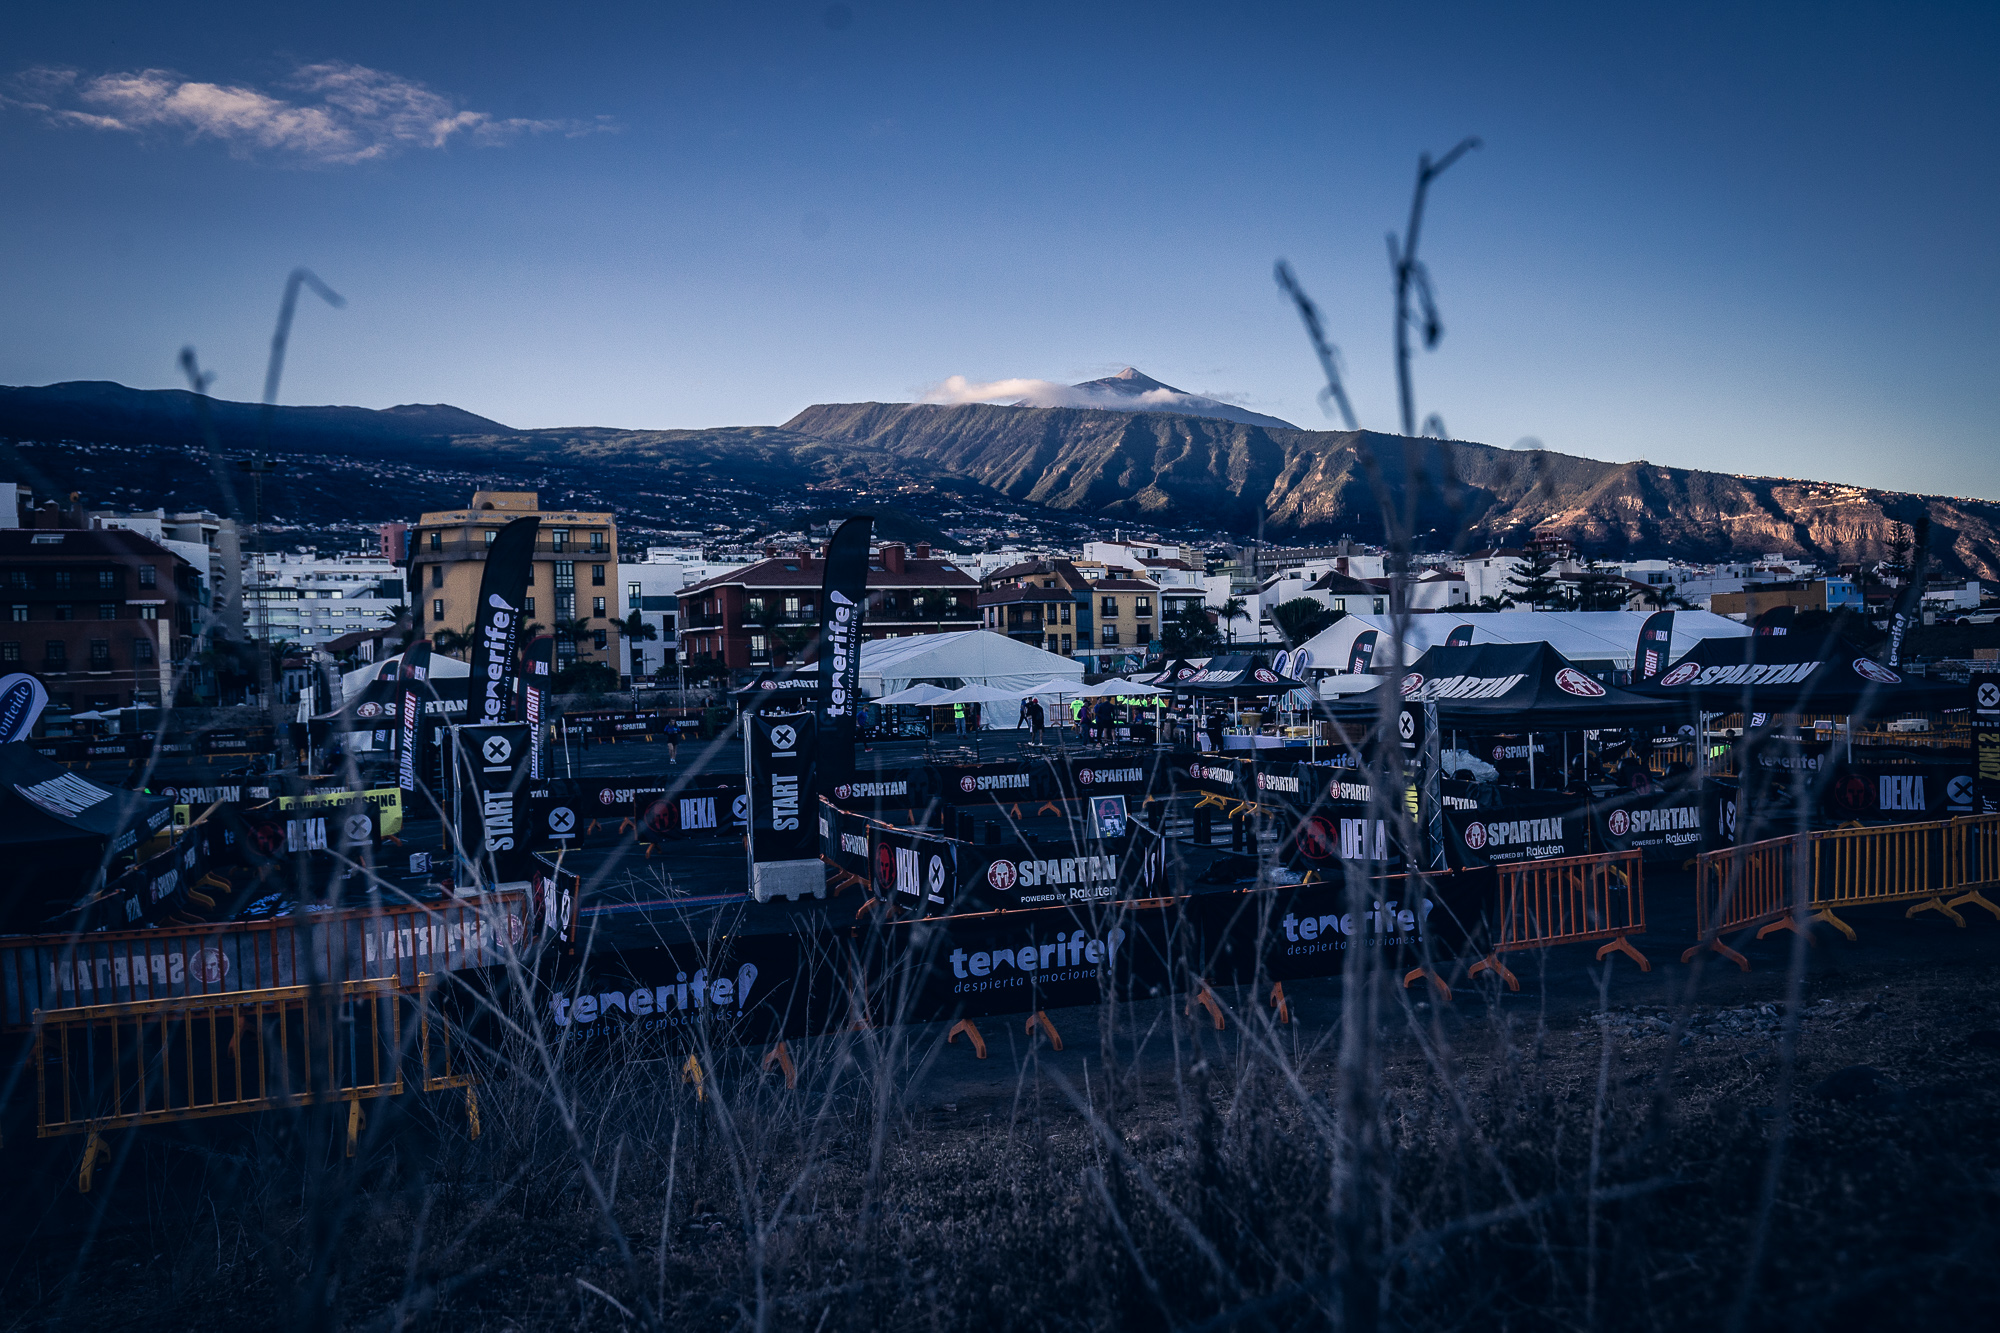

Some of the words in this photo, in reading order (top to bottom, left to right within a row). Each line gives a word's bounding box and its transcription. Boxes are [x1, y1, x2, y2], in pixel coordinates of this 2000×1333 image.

[1655, 630, 1668, 642] DEKA
[827, 590, 858, 718] tenerife!
[535, 661, 549, 676] DEKA
[1691, 661, 1820, 686] SPARTAN
[845, 667, 855, 717] despierta
[1413, 674, 1526, 698] SPARTAN
[0, 685, 29, 737] onteide
[622, 722, 647, 731] SPARTAN
[1978, 733, 2000, 743] 2
[95, 746, 126, 755] SPARTAN
[217, 741, 247, 749] SPARTAN
[1979, 744, 2000, 780] ZONE
[977, 773, 1030, 790] SPARTAN
[1095, 767, 1143, 783] SPARTAN
[1208, 767, 1235, 785] SPARTAN
[1266, 776, 1299, 794] SPARTAN
[180, 786, 241, 805] SPARTAN
[852, 781, 908, 798] SPARTAN
[1341, 783, 1374, 803] SPARTA
[1879, 775, 1926, 811] DEKA
[680, 797, 718, 831] DEKA
[771, 773, 799, 831] START
[483, 790, 515, 852] START
[1488, 817, 1563, 846] SPARTAN
[1631, 807, 1701, 833] SPARTAN
[287, 817, 328, 853] DEKA
[1666, 832, 1702, 844] Rakuten
[1490, 852, 1516, 861] POWERED
[1526, 844, 1565, 857] Rakuten
[895, 847, 920, 897] DEKA
[1018, 855, 1117, 887] SPARTAN
[1021, 894, 1056, 903] POWERED
[1056, 893, 1067, 901] BY
[1069, 886, 1118, 900] Rakuten
[949, 927, 1126, 979] tenerife!
[1287, 940, 1347, 956] despierta
[954, 976, 1024, 994] despierta
[1030, 968, 1097, 984] emocione
[549, 963, 758, 1027] tenerife!
